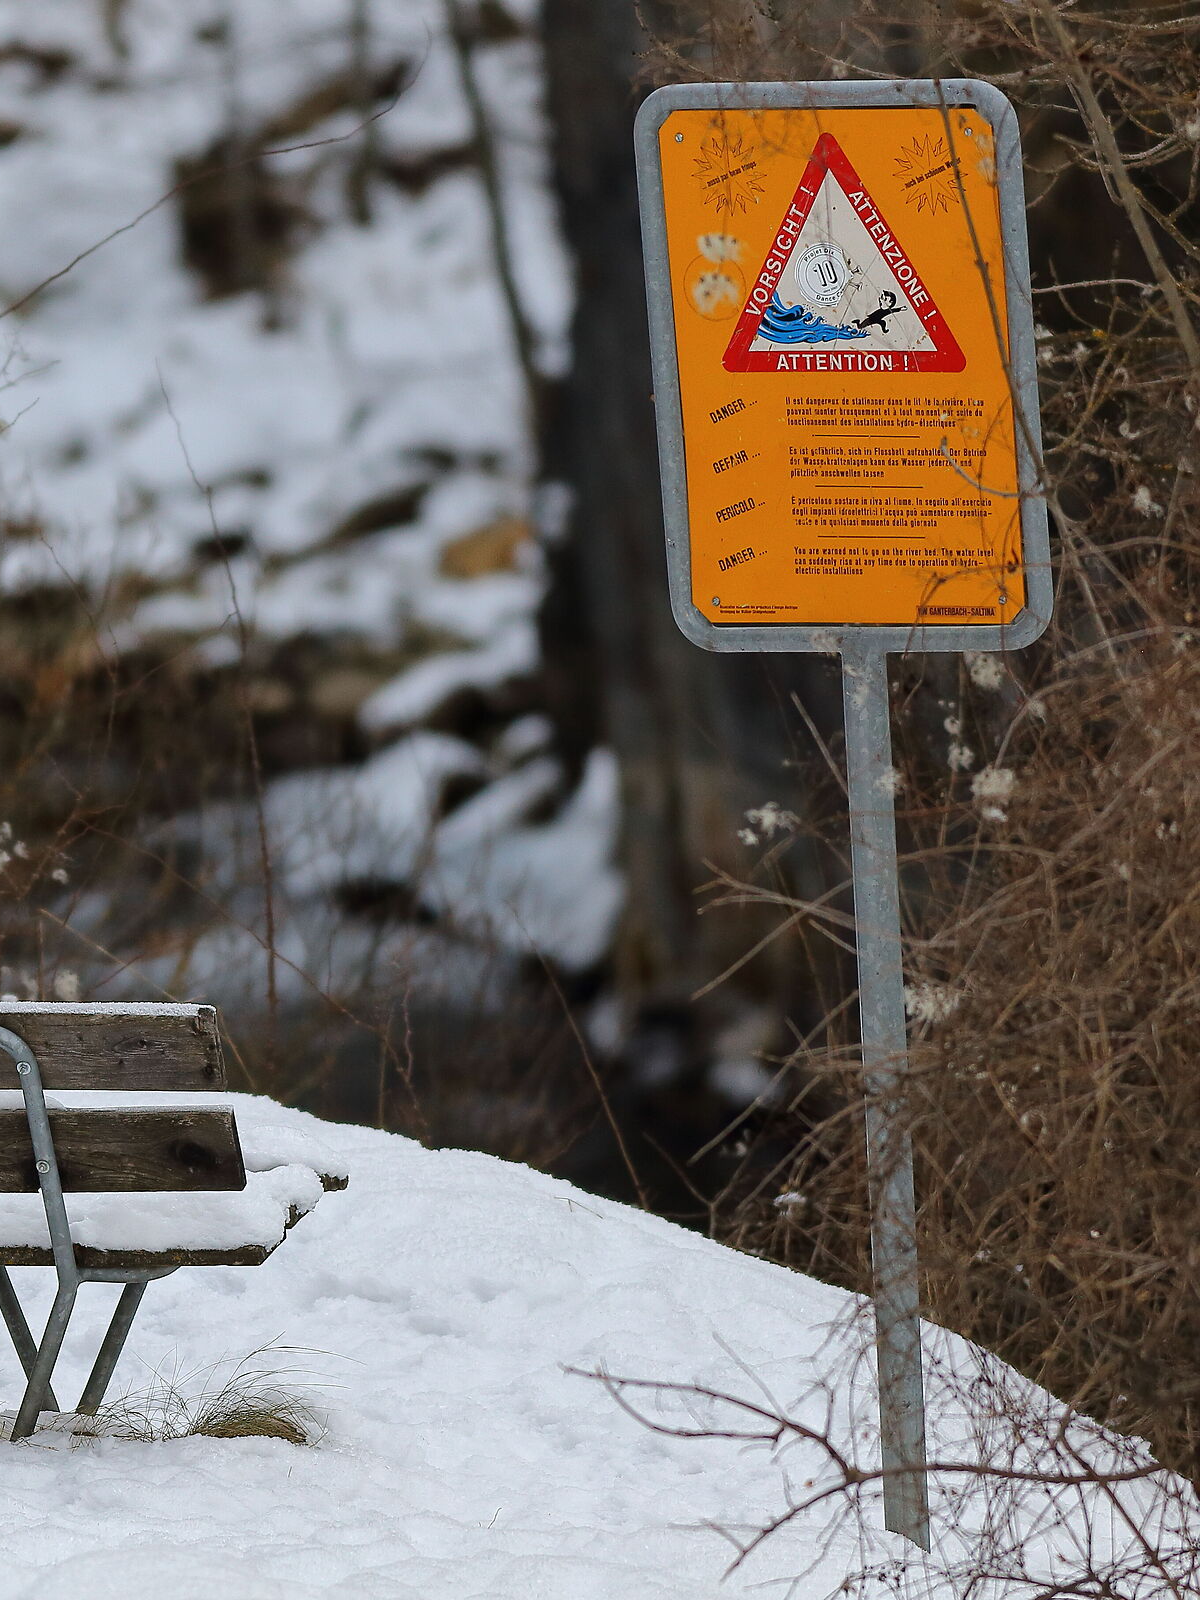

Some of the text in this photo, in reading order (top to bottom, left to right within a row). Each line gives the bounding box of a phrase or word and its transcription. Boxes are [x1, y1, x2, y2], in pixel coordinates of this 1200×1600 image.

[944, 157, 961, 169] Weer
[745, 185, 817, 318] VORSICHT !
[849, 190, 938, 320] ATTENZIONE !
[812, 259, 838, 287] 10
[815, 294, 836, 302] Dance
[776, 354, 909, 371] ATTENTION !
[793, 397, 804, 405] est
[806, 397, 839, 407] dangereux
[841, 397, 849, 405] de
[852, 397, 885, 406] stationner
[888, 397, 903, 406] dans
[905, 397, 911, 406] le
[942, 397, 966, 407] rivière,
[709, 398, 747, 424] DANGER
[786, 408, 812, 416] pouvant
[839, 407, 881, 417] brusquement
[883, 408, 890, 416] et
[893, 407, 897, 416] à
[899, 408, 912, 416] tout
[956, 408, 973, 417] suite
[974, 408, 983, 417] du
[787, 417, 837, 426] fonctionnement
[840, 418, 852, 426] des
[853, 418, 895, 426] installations
[789, 446, 797, 455] Es
[800, 446, 809, 455] ist
[810, 447, 846, 456] gefährlich,
[848, 447, 862, 456] sich
[874, 447, 905, 456] Flussbett
[949, 448, 961, 457] Der
[963, 448, 987, 457] Betrieb
[712, 450, 749, 474] GEFAHR
[789, 457, 801, 465] der
[803, 457, 868, 467] Wasserkraftanlagen
[869, 457, 886, 466] kann
[887, 457, 899, 466] das
[901, 458, 925, 466] Wasser
[960, 458, 972, 467] und
[790, 468, 885, 478] plötzlich anschwellen lassen
[798, 496, 832, 506] pericoloso
[834, 497, 859, 505] sostare
[861, 497, 868, 505] in
[869, 497, 882, 505] riva
[884, 497, 891, 505] al
[893, 497, 914, 506] fiume.
[916, 497, 923, 506] In
[925, 498, 949, 507] seguito
[951, 498, 992, 507] all'esercizio
[716, 497, 756, 524] PERICOLO
[791, 507, 808, 516] degli
[810, 507, 837, 517] impianti
[879, 508, 904, 518] l'acqua
[906, 507, 918, 518] può
[920, 508, 954, 517] aumentare
[820, 517, 827, 526] in
[829, 518, 859, 527] qualsiasi
[861, 518, 890, 526] momento
[892, 518, 908, 526] della
[910, 518, 937, 528] giornata
[794, 546, 807, 555] You
[822, 547, 846, 555] warned
[848, 547, 859, 555] not
[862, 547, 869, 555] to
[871, 549, 879, 557] go
[892, 548, 903, 556] the
[905, 548, 921, 556] river
[924, 548, 939, 557] bed.
[941, 548, 953, 556] The
[956, 548, 974, 557] water
[977, 548, 994, 557] level
[718, 547, 756, 572] DANGER
[808, 557, 837, 567] suddenly
[839, 557, 853, 565] rise
[855, 558, 862, 566] at
[863, 559, 875, 567] any
[878, 558, 893, 566] time
[895, 558, 907, 566] due
[909, 558, 916, 566] to
[917, 558, 949, 568] operation
[950, 558, 957, 566] of
[795, 566, 863, 575] electric installations
[929, 607, 995, 616] GANTERBACH-SALTINA
